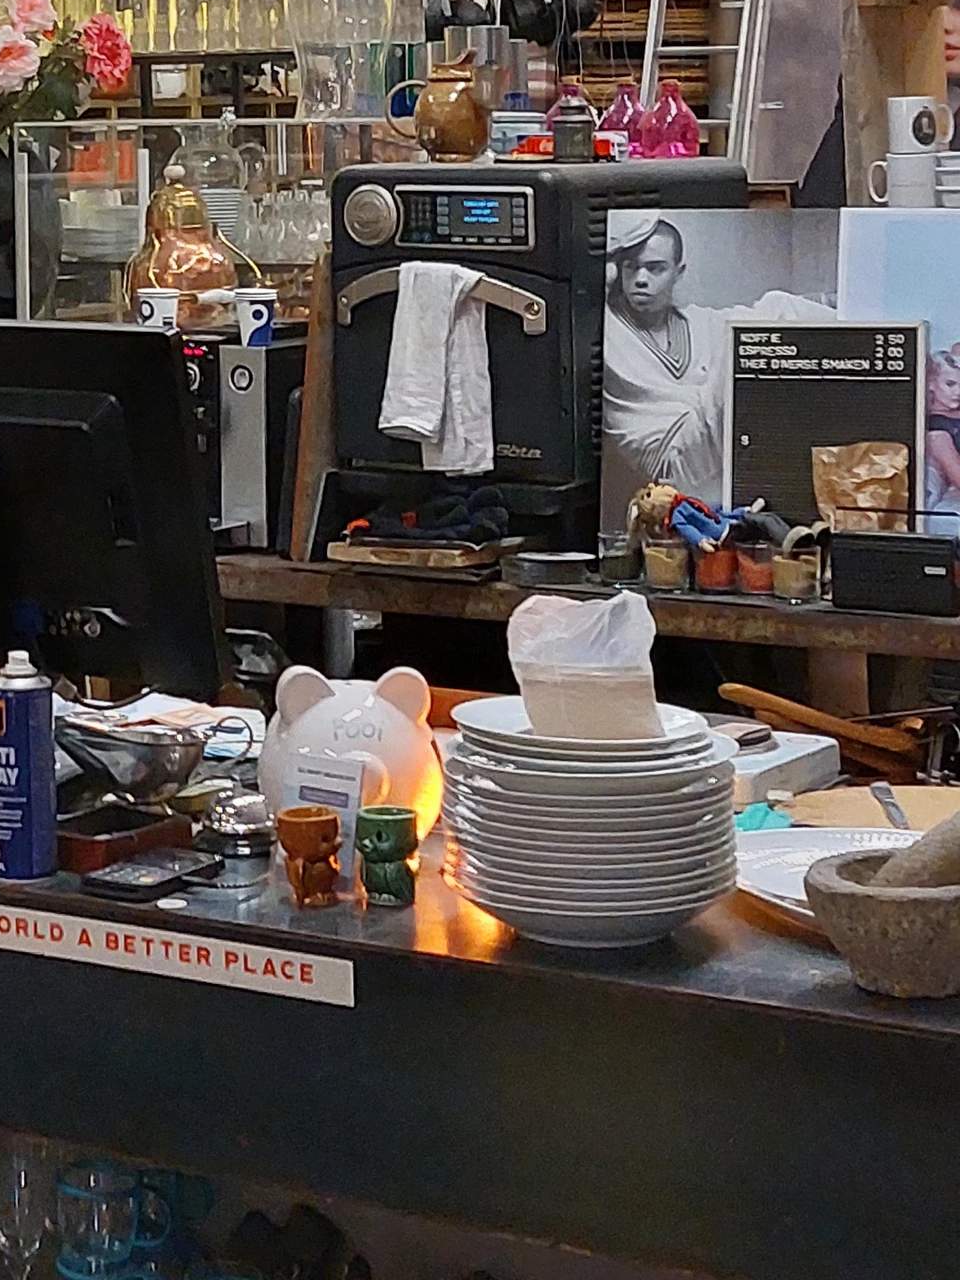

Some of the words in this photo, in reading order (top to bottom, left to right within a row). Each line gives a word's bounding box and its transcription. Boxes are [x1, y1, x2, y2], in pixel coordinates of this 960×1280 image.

[740, 333, 782, 344] KOFFIE
[887, 333, 905, 345] 50
[739, 345, 798, 357] ESPRESSO
[739, 358, 768, 370] THEE
[771, 358, 820, 371] DIVERSE
[821, 358, 871, 371] SMAKEN
[77, 928, 92, 948] A
[105, 932, 212, 967] BETTER
[224, 950, 314, 985] PLACE
